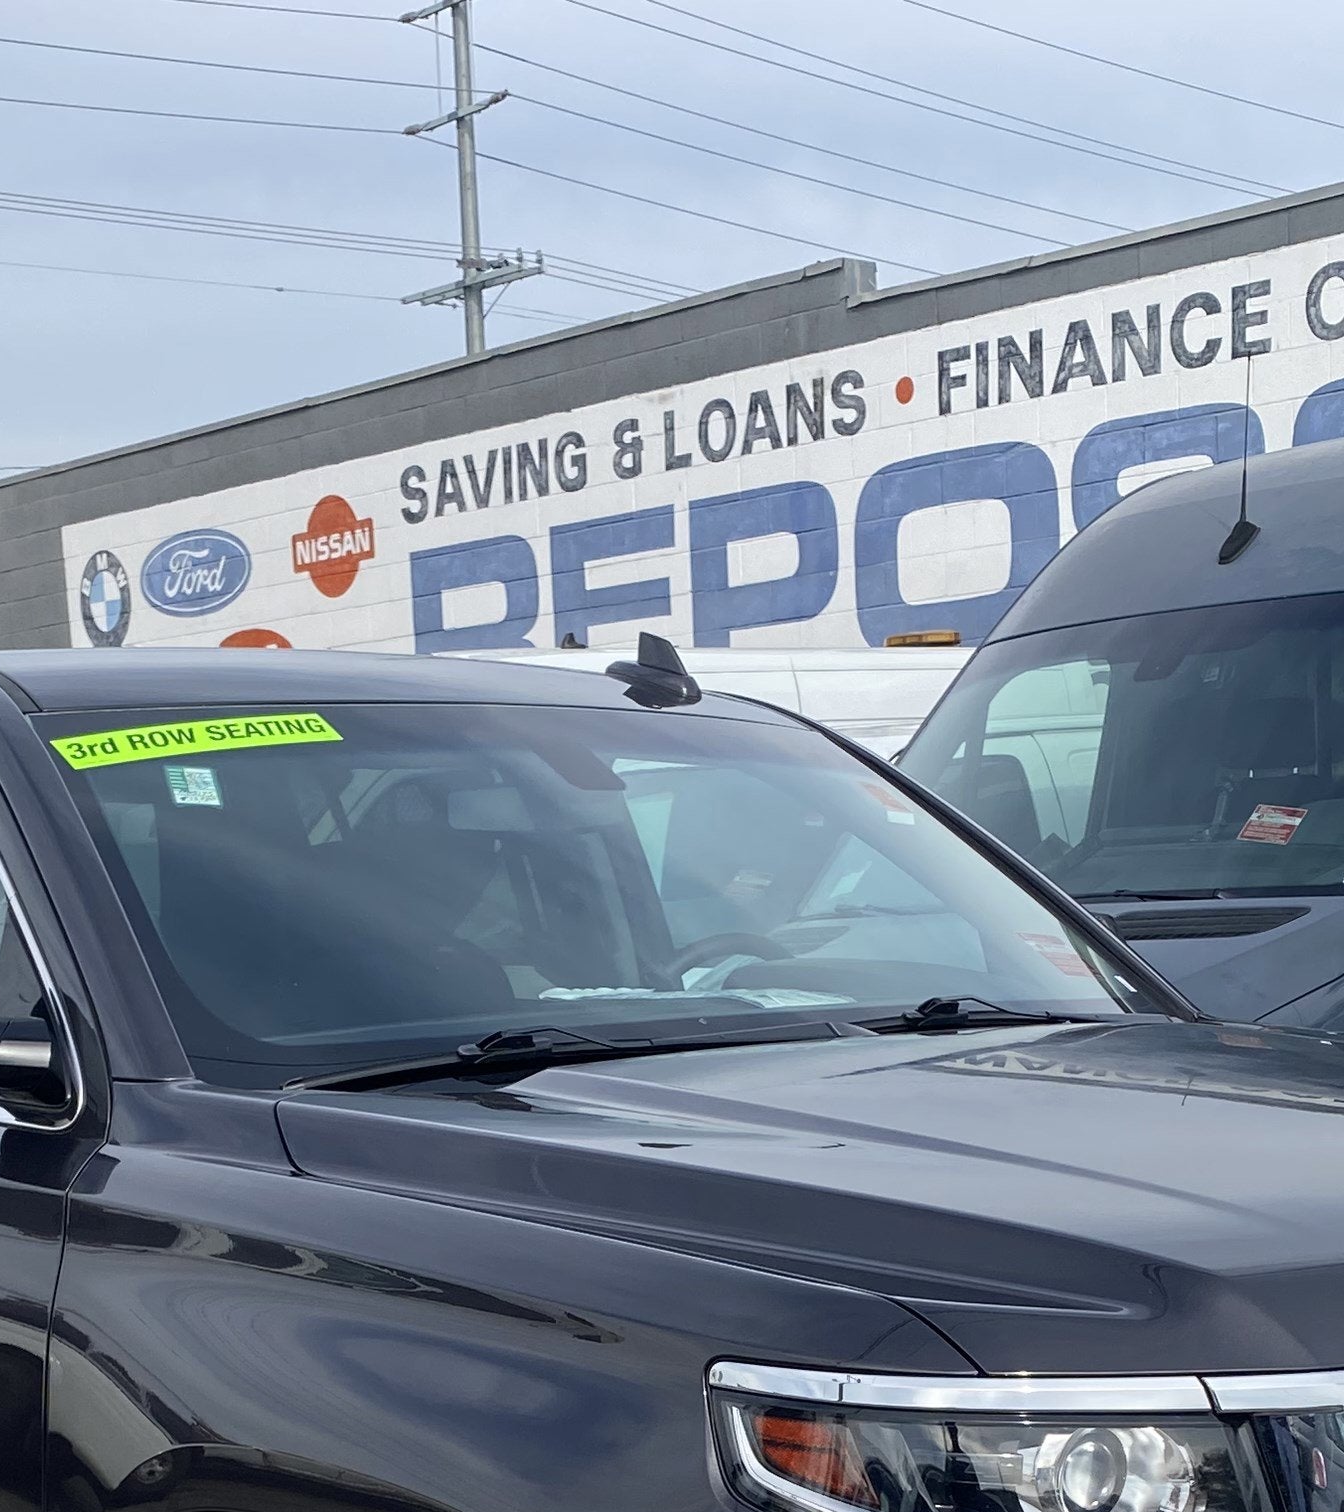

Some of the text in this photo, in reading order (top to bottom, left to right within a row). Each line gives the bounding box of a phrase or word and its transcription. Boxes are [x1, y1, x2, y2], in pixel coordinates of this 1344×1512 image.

[399, 430, 589, 525] SAVING
[612, 418, 644, 480] &
[664, 369, 868, 469] LOANS
[937, 279, 1273, 416] FINANCE
[294, 526, 372, 566] NISSAN
[164, 548, 227, 599] Ford
[65, 717, 327, 760] 3rd ROW SEATING
